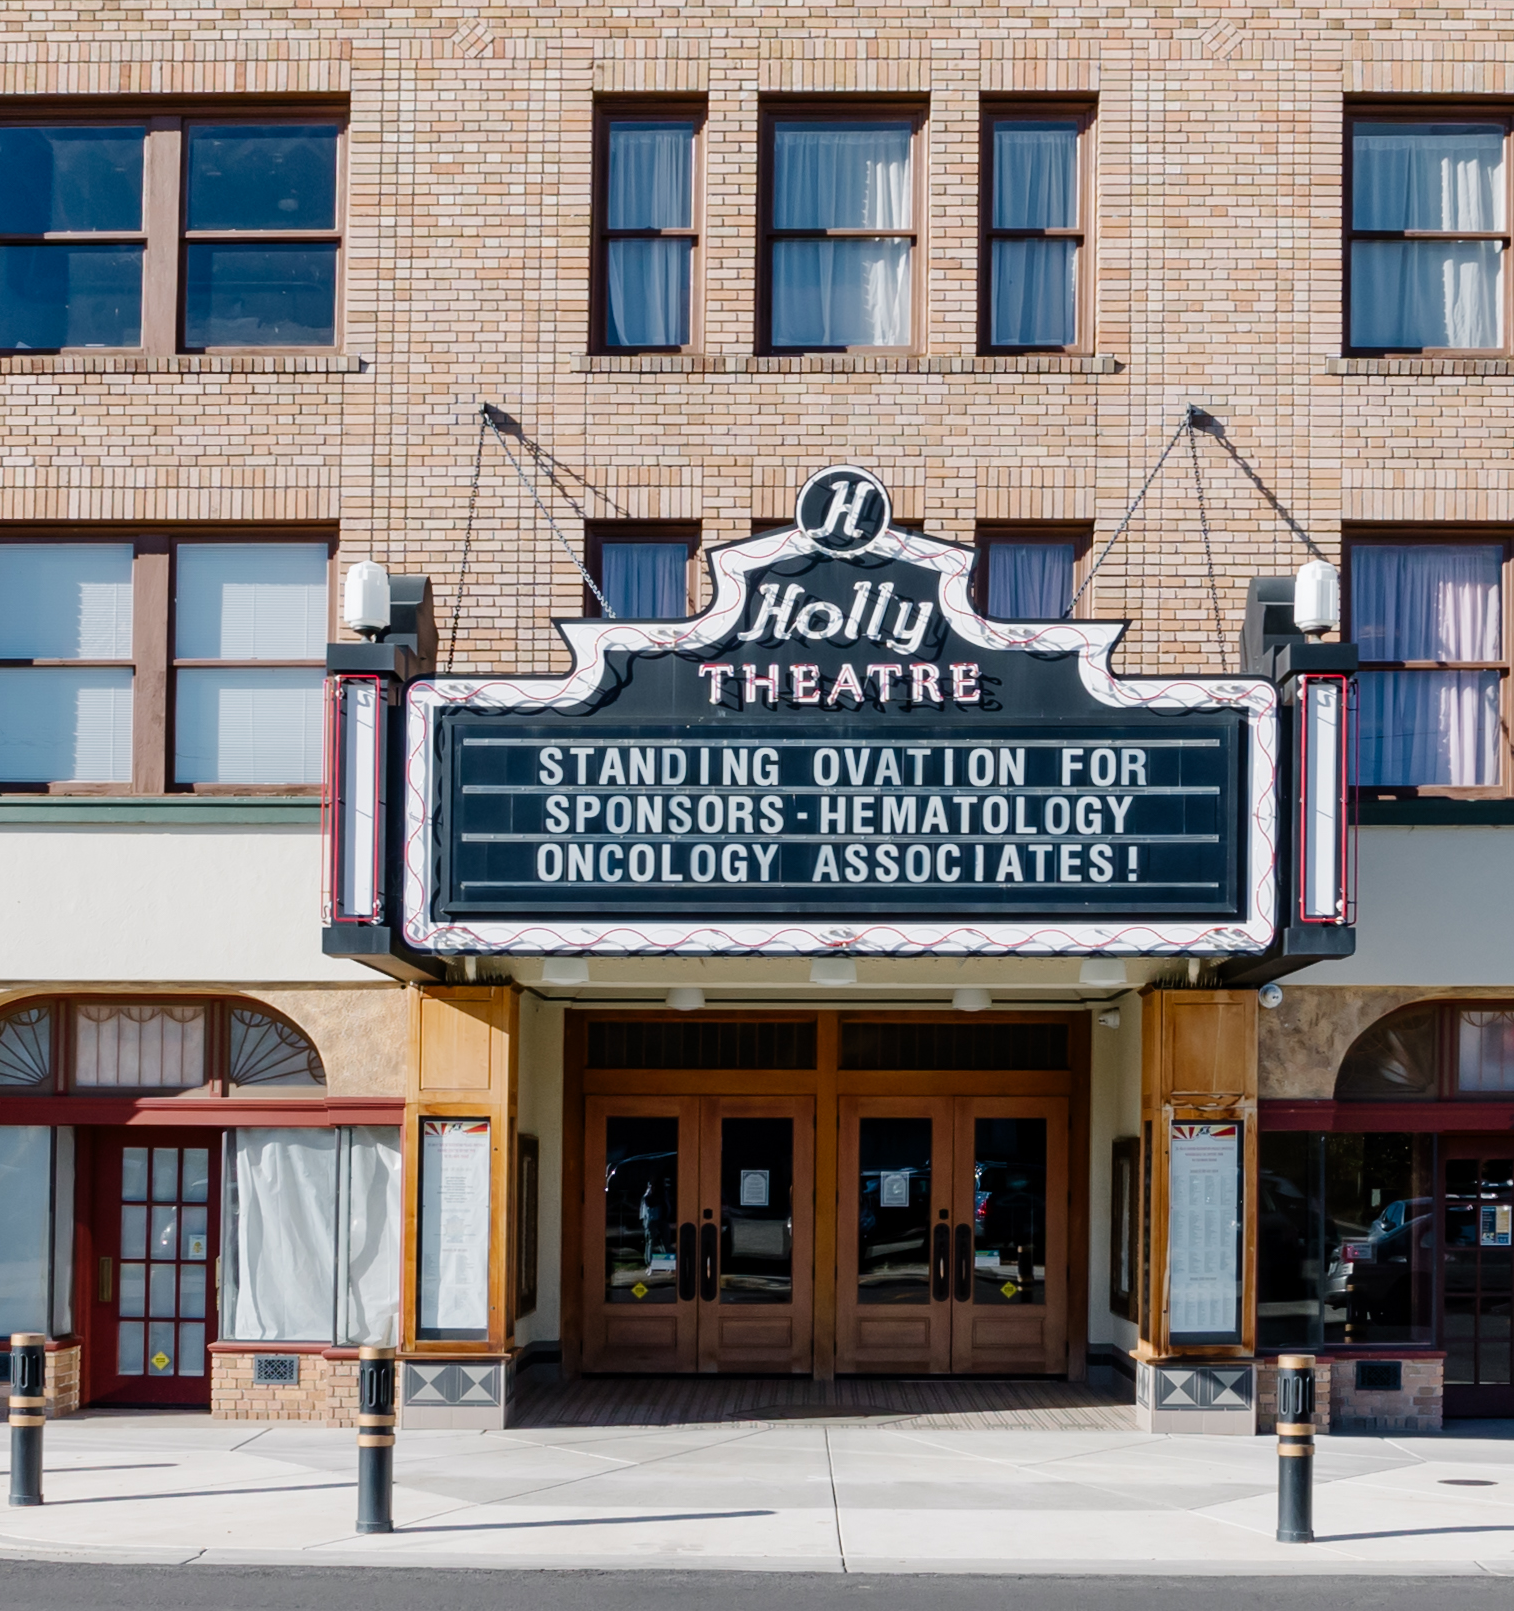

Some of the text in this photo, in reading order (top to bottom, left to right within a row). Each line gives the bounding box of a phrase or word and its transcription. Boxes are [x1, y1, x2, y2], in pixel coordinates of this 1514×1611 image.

[807, 480, 876, 539] H
[737, 581, 934, 655] Holly
[698, 663, 981, 705] THEATRE
[539, 746, 1147, 787] STANDING OVATION FOR
[537, 843, 1138, 883] ONCOLOGY ASSOCIATES!
